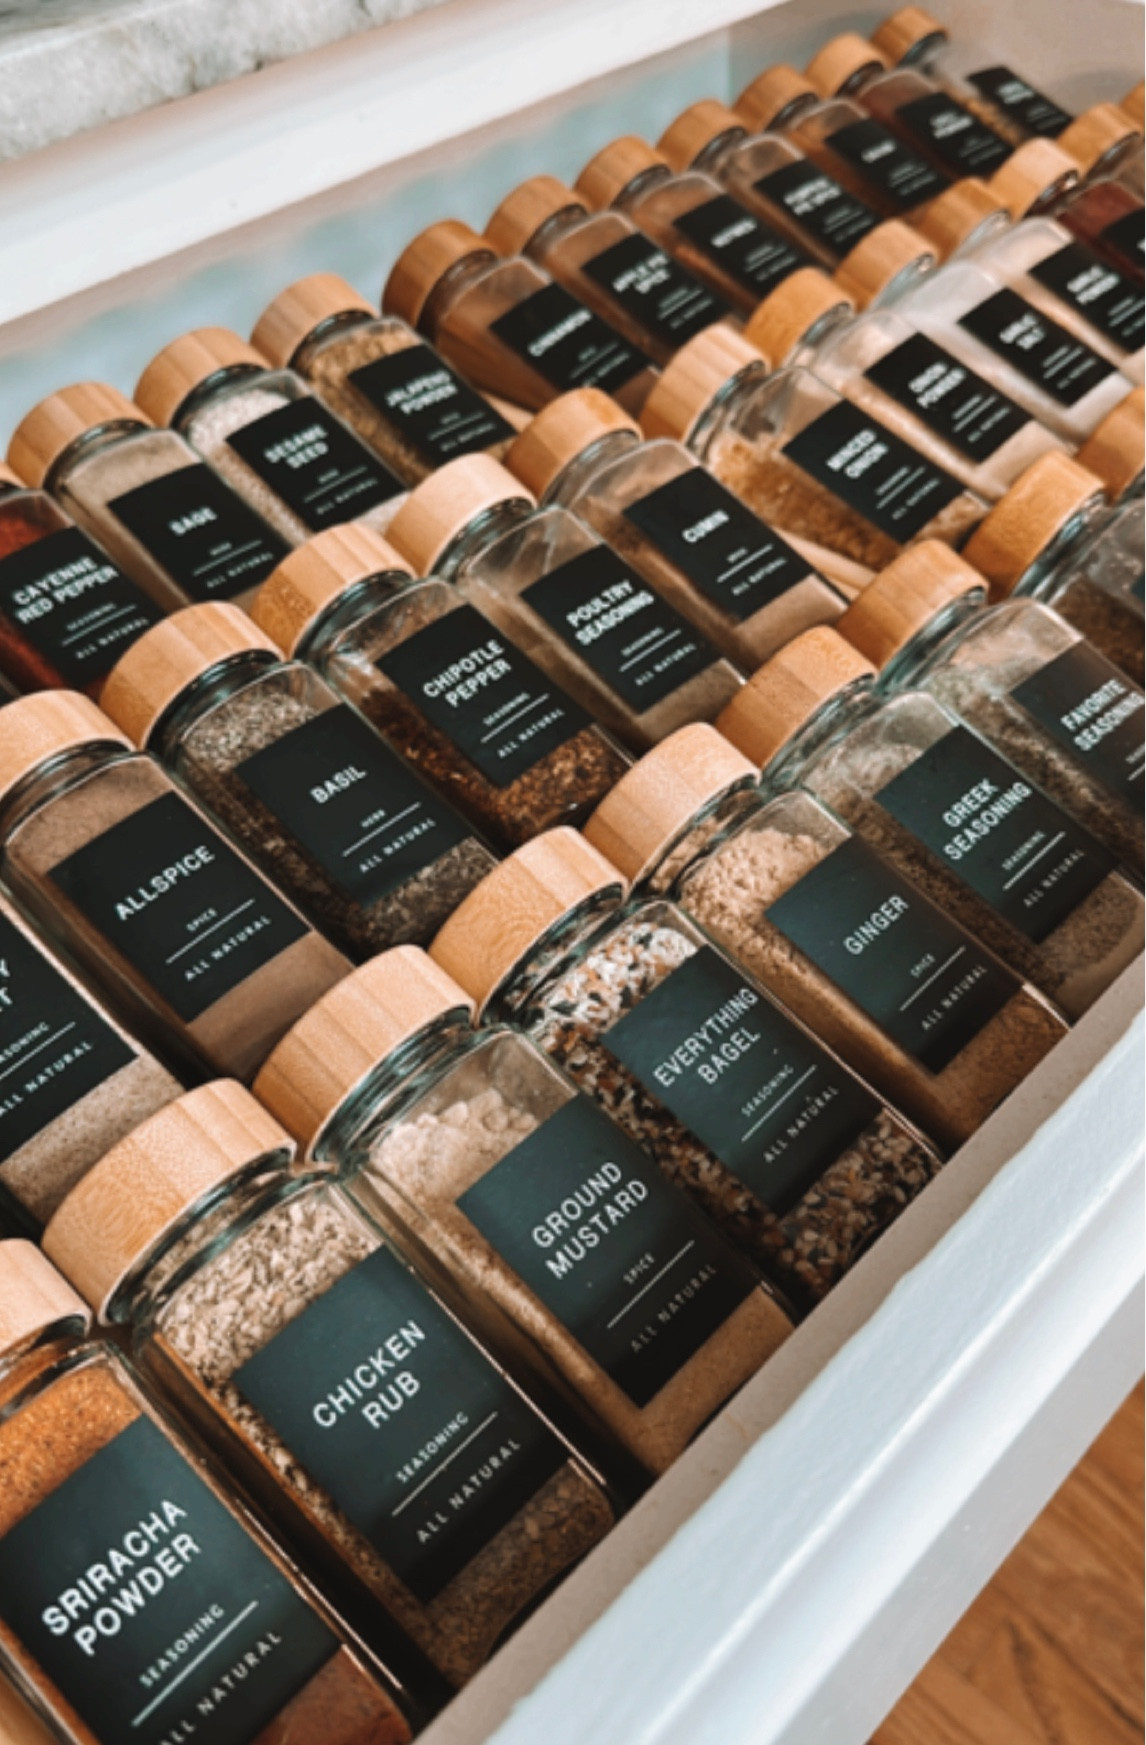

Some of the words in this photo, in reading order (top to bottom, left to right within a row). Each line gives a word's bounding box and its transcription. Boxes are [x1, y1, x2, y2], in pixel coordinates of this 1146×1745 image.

[169, 507, 218, 536] SAGE
[12, 556, 98, 605] CAYENNE
[15, 597, 54, 624] RED
[52, 566, 119, 604] PEPPER
[566, 579, 633, 627] POULTRY
[575, 590, 654, 645] SEASONING
[422, 639, 505, 698] CHIPOTLE
[445, 658, 512, 708] PEPPER
[518, 708, 565, 743] NATURAL
[1060, 679, 1127, 730] FAVORITE
[1073, 690, 1144, 751] SEASONING
[310, 766, 368, 804] BASIL
[942, 778, 998, 828] GREEK
[358, 856, 381, 873] ALL
[383, 817, 436, 856] NATURAL
[943, 781, 1034, 860] SEASONING
[113, 846, 216, 921] ALLSPICE
[1023, 888, 1045, 908] ALL
[1042, 848, 1085, 887] NATURAL
[184, 961, 212, 982] ALL
[211, 916, 272, 965] NATURAL
[186, 908, 217, 932] SPICE
[843, 895, 910, 956] GINGER
[910, 953, 936, 977] SPICE
[921, 1008, 944, 1031] ALL
[942, 965, 988, 1009] NATURAL
[25, 1040, 92, 1092] NATURAL
[653, 988, 759, 1088] EVERYTHING
[697, 1028, 761, 1085] BAGEL
[740, 1064, 794, 1117] SEASONING
[763, 1139, 789, 1163] ALL
[788, 1085, 840, 1140] NATURAL
[532, 1161, 622, 1248] GROUND
[545, 1180, 649, 1280] MUSTARD
[623, 1252, 656, 1284] SPICE
[630, 1326, 657, 1353] ALL
[657, 1264, 717, 1323] NATURAL
[312, 1320, 426, 1428] CHICKEN
[360, 1370, 420, 1429] RUB
[396, 1411, 469, 1484] SEASONING
[416, 1510, 449, 1544] ALL
[449, 1438, 522, 1511] NATURAL
[41, 1500, 188, 1637] SRIRACHA
[73, 1533, 202, 1656] POWDER
[139, 1604, 224, 1687] SEASONING
[197, 1632, 282, 1715] NATURAL
